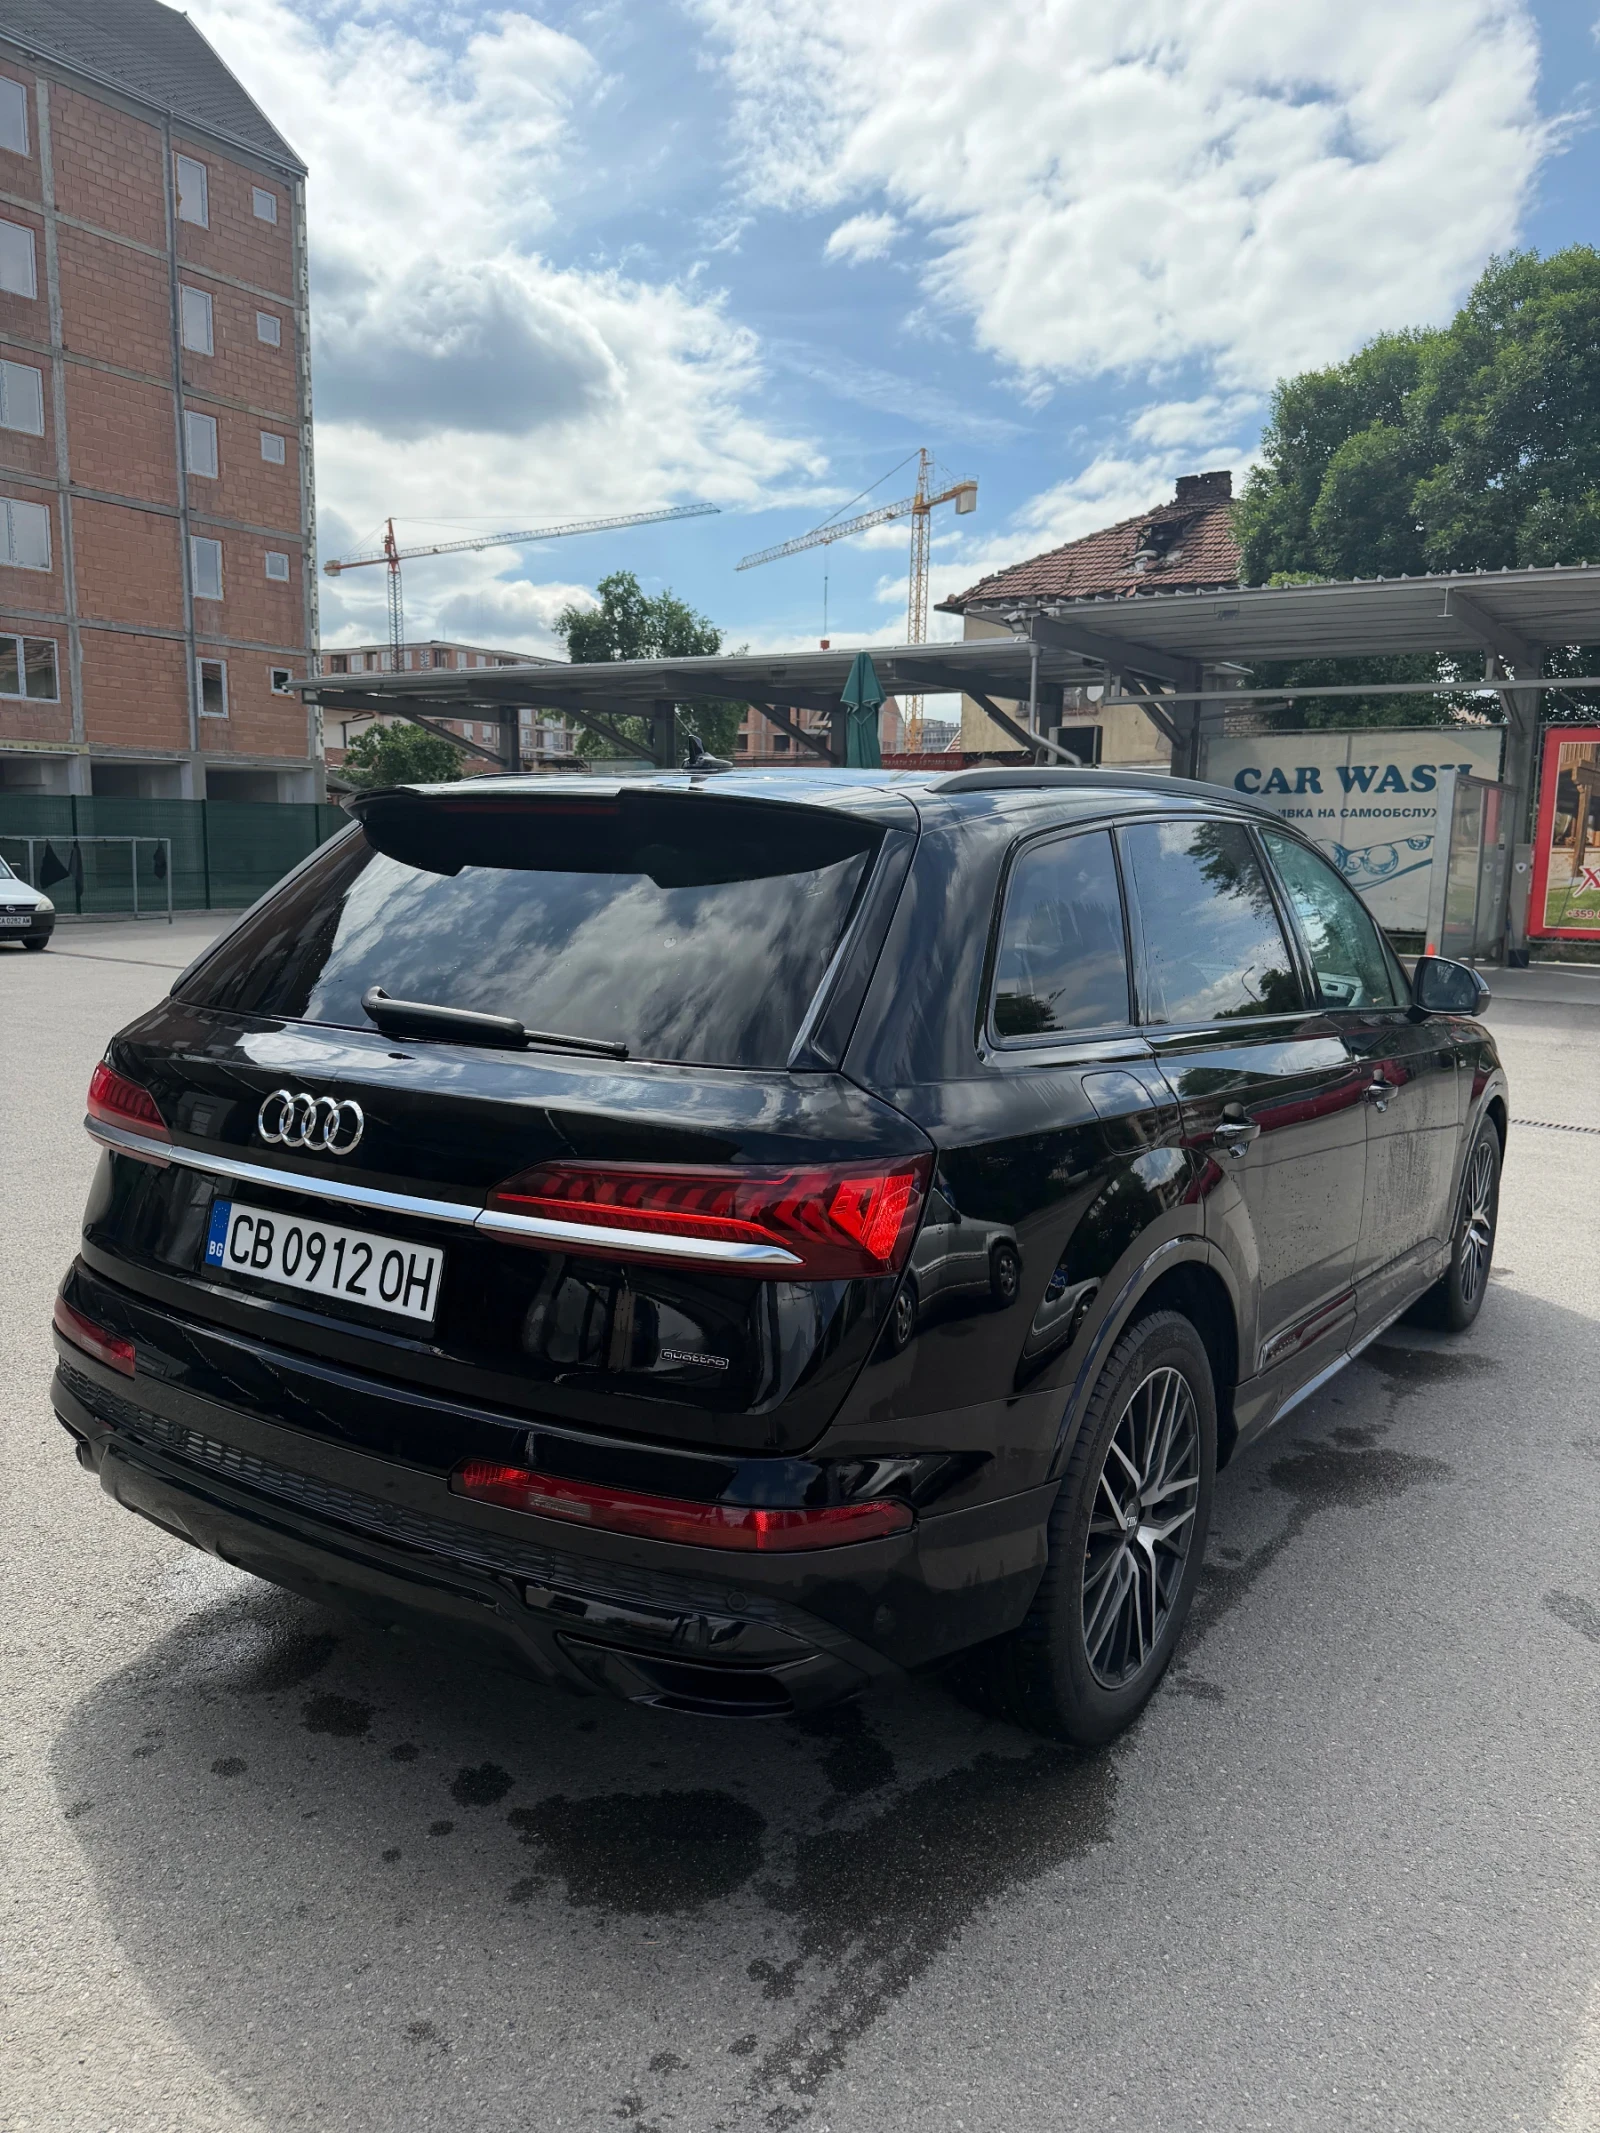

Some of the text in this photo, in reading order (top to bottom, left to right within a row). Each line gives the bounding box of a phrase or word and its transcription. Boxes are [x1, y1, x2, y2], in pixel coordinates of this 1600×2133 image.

[1234, 764, 1473, 794] CAR WAS
[1277, 808, 1313, 818] ИВКА
[1317, 808, 1336, 818] НА
[1567, 909, 1595, 919] +359
[208, 1240, 223, 1258] BG
[229, 1214, 434, 1312] CB 0912 OH
[663, 1350, 726, 1366] quattro
